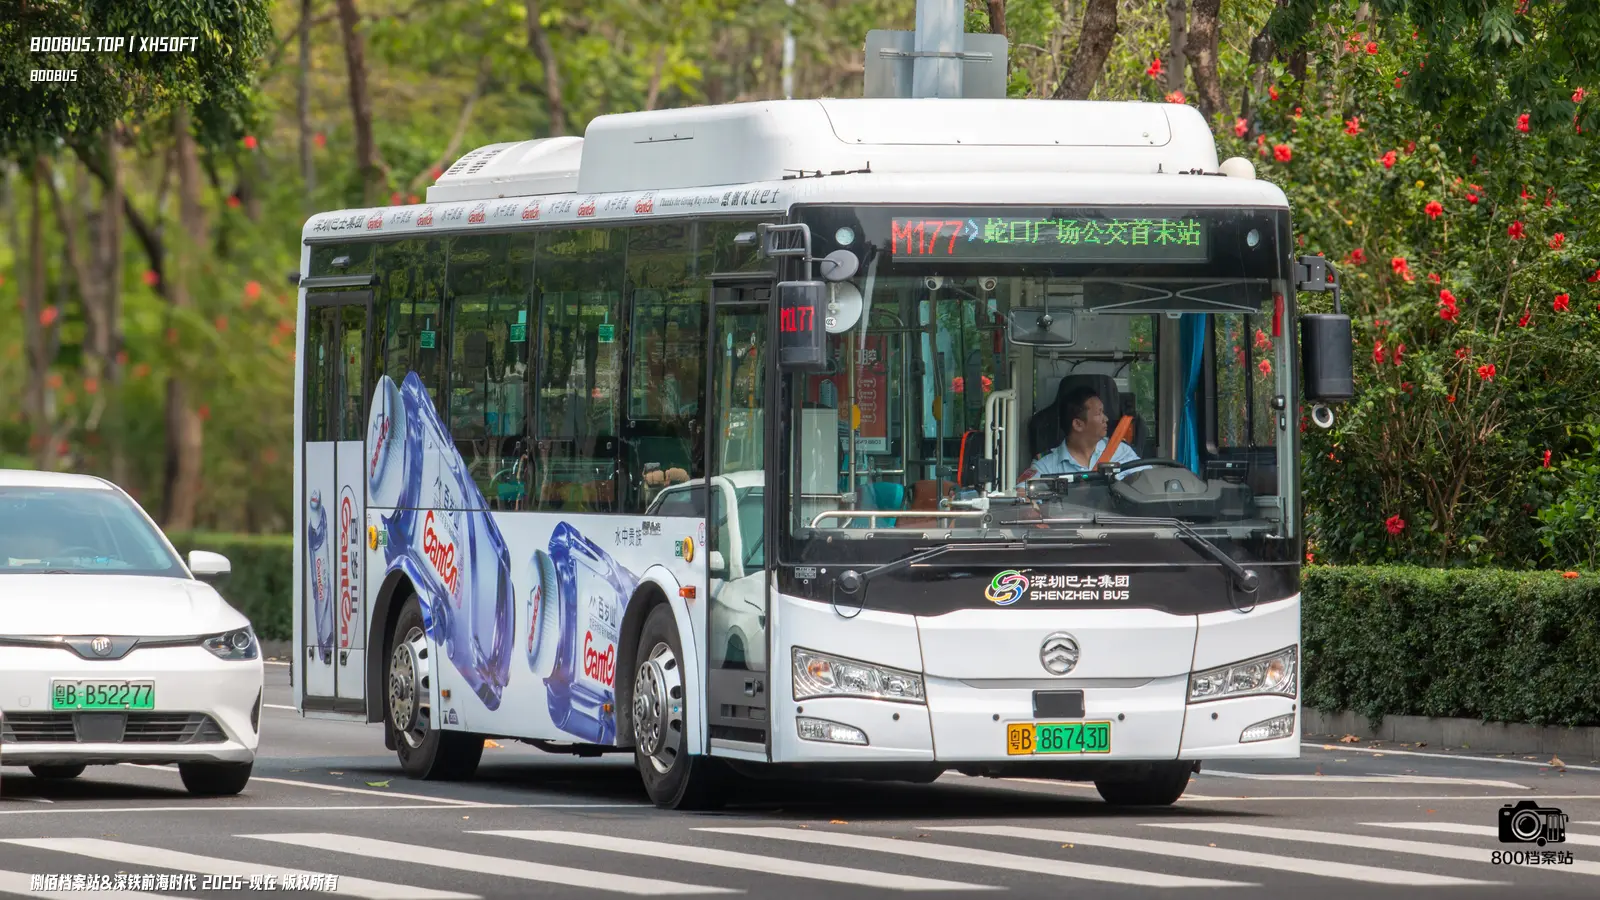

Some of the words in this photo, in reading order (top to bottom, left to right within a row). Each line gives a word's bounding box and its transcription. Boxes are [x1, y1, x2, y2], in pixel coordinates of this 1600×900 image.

[720, 188, 779, 206] 感谢礼让巴士
[313, 214, 365, 233] 深圳巴士集团
[984, 217, 1201, 246] 蛇口广场公交首末站
[891, 220, 964, 255] M177
[780, 306, 815, 331] M177
[614, 527, 642, 547] 水中贵族
[423, 510, 458, 595] Ganten
[341, 496, 352, 649] Ganten
[351, 518, 359, 614] 百岁山
[1031, 574, 1130, 588] 深圳巴士集团
[1031, 590, 1099, 601] SHENZHEN
[1104, 590, 1130, 601] BUS
[598, 596, 616, 629] 百岁山
[86, 684, 153, 705] B52277
[1041, 726, 1108, 750] 86743D
